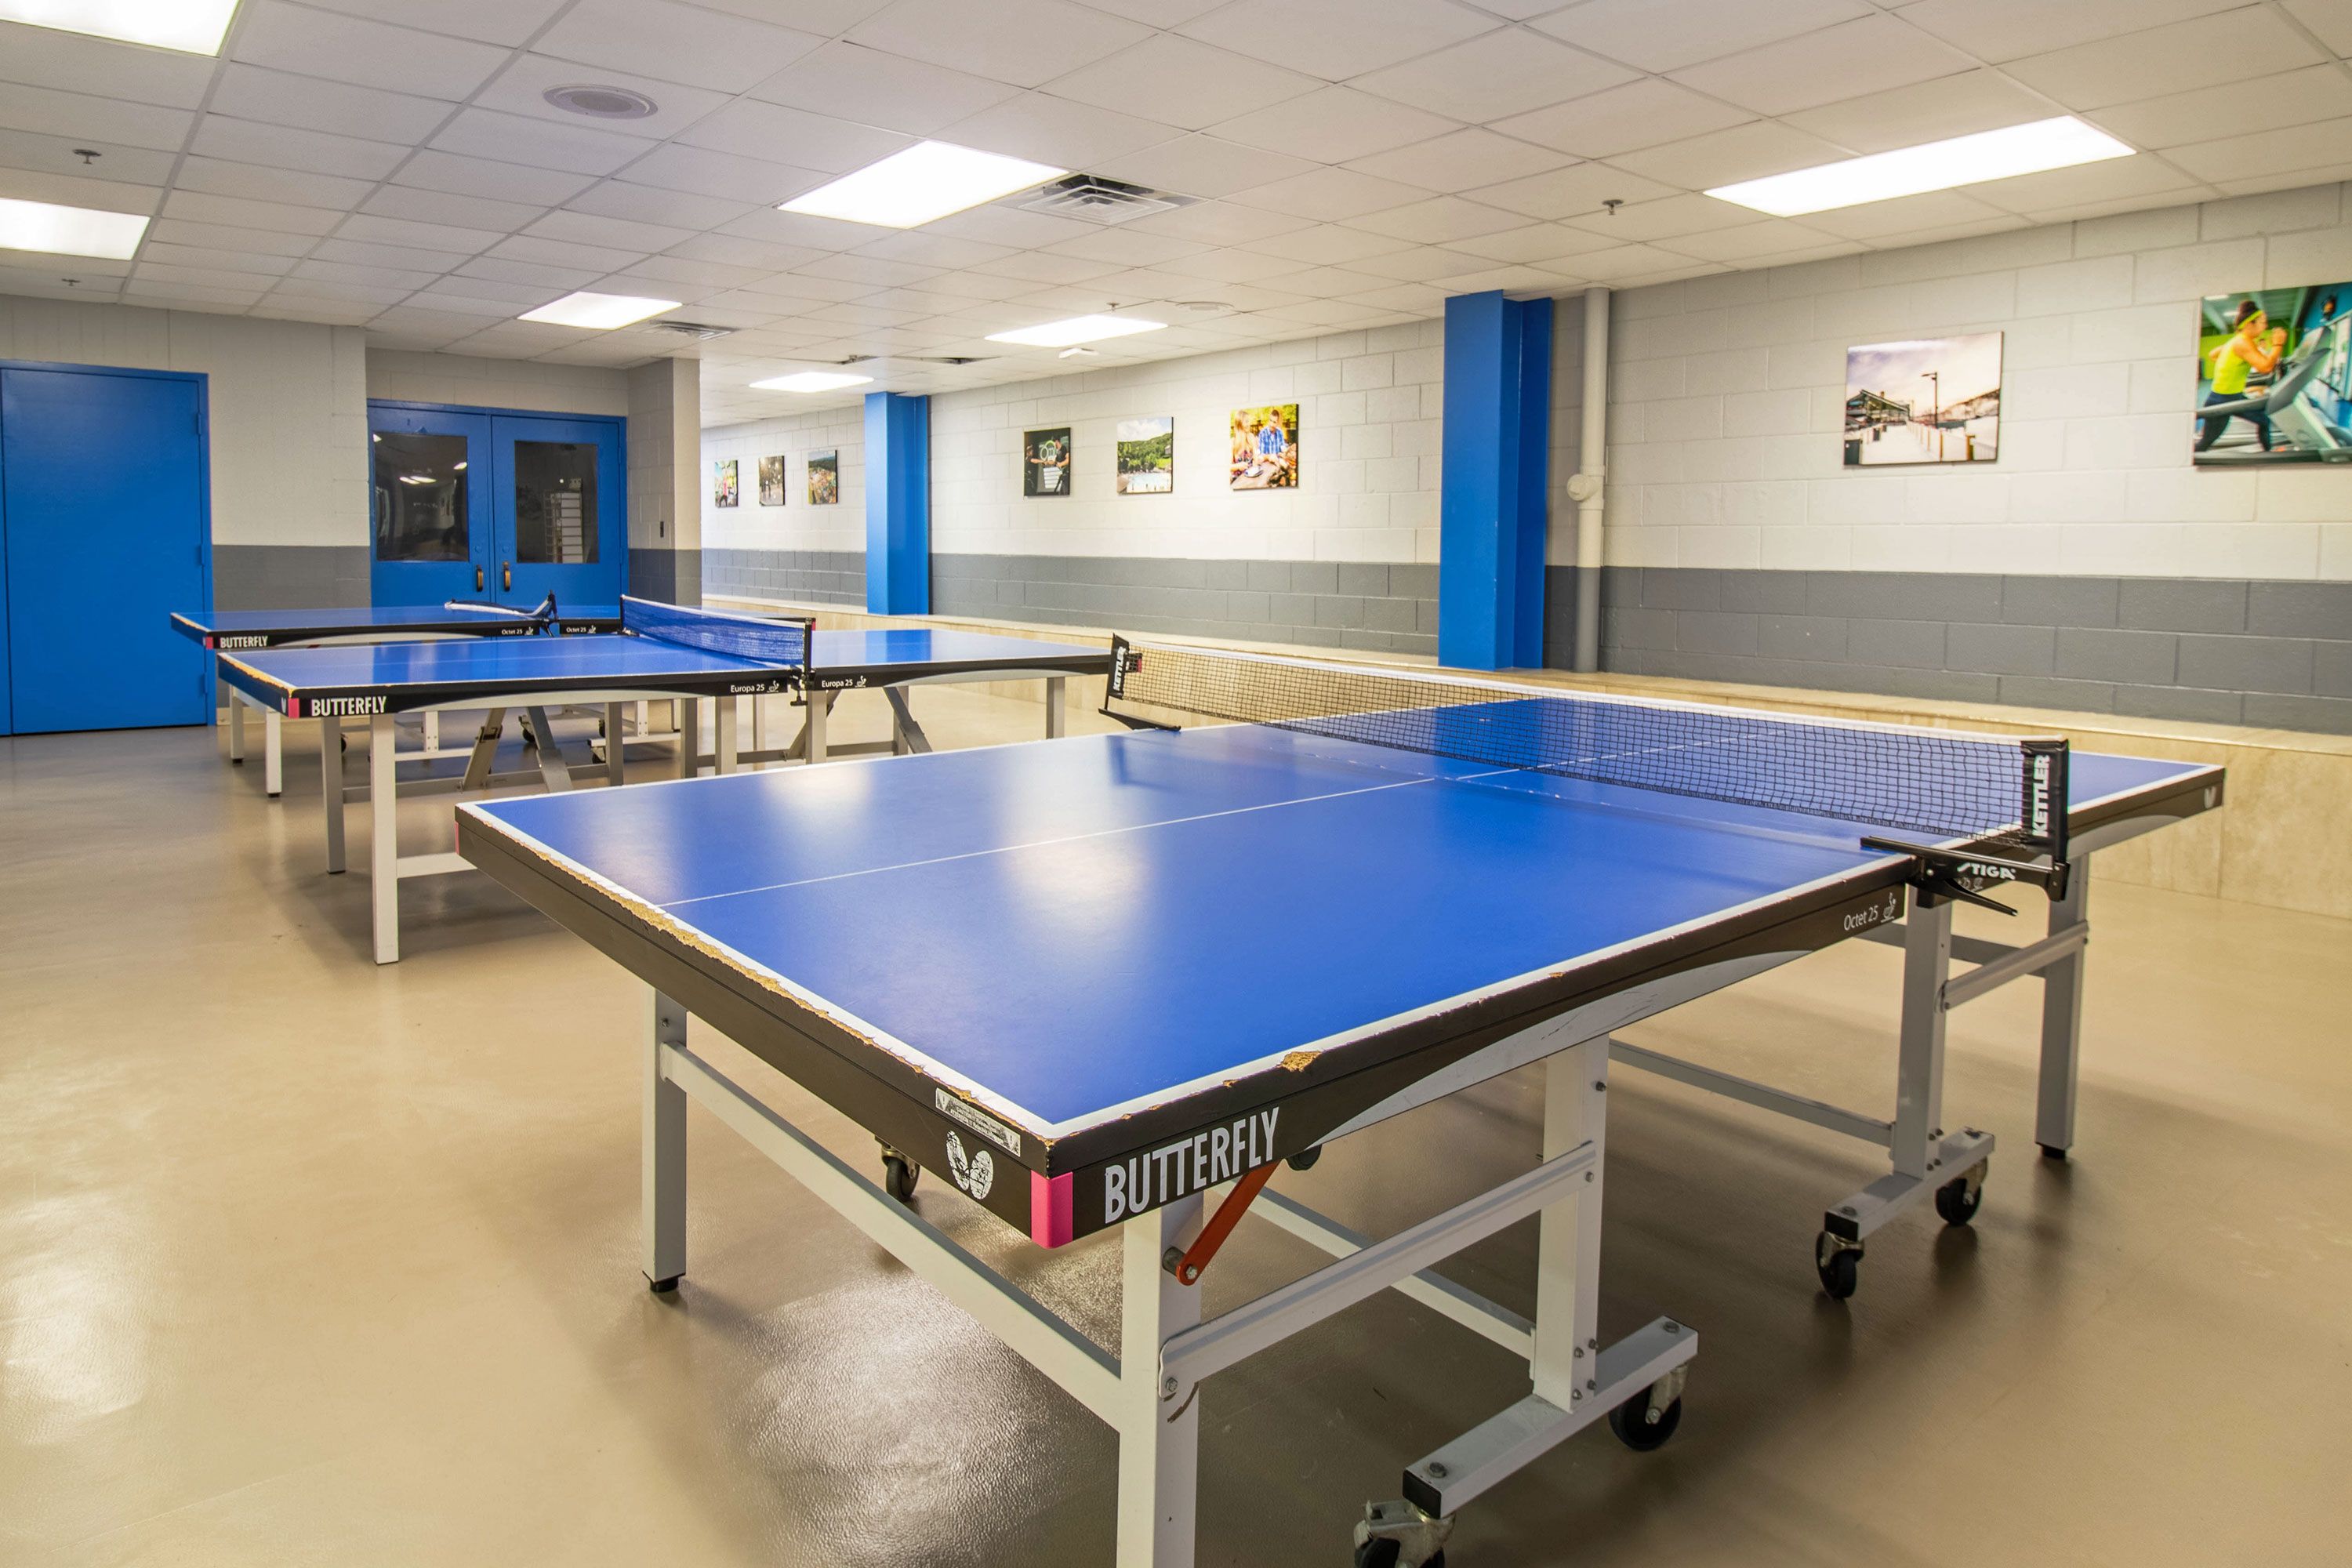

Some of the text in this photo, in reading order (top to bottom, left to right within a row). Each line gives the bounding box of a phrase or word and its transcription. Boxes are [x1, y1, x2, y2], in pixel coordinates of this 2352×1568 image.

[220, 636, 268, 649] BUTTERFLY
[731, 683, 765, 693] Europa 25
[822, 678, 854, 688] Europa 25
[311, 696, 387, 717] BUTTERFLY
[2032, 754, 2051, 837] KETTLER
[1957, 862, 2016, 880] STIGA
[1843, 905, 1879, 931] Octet 25
[1105, 1106, 1279, 1225] BUTTERFLY
